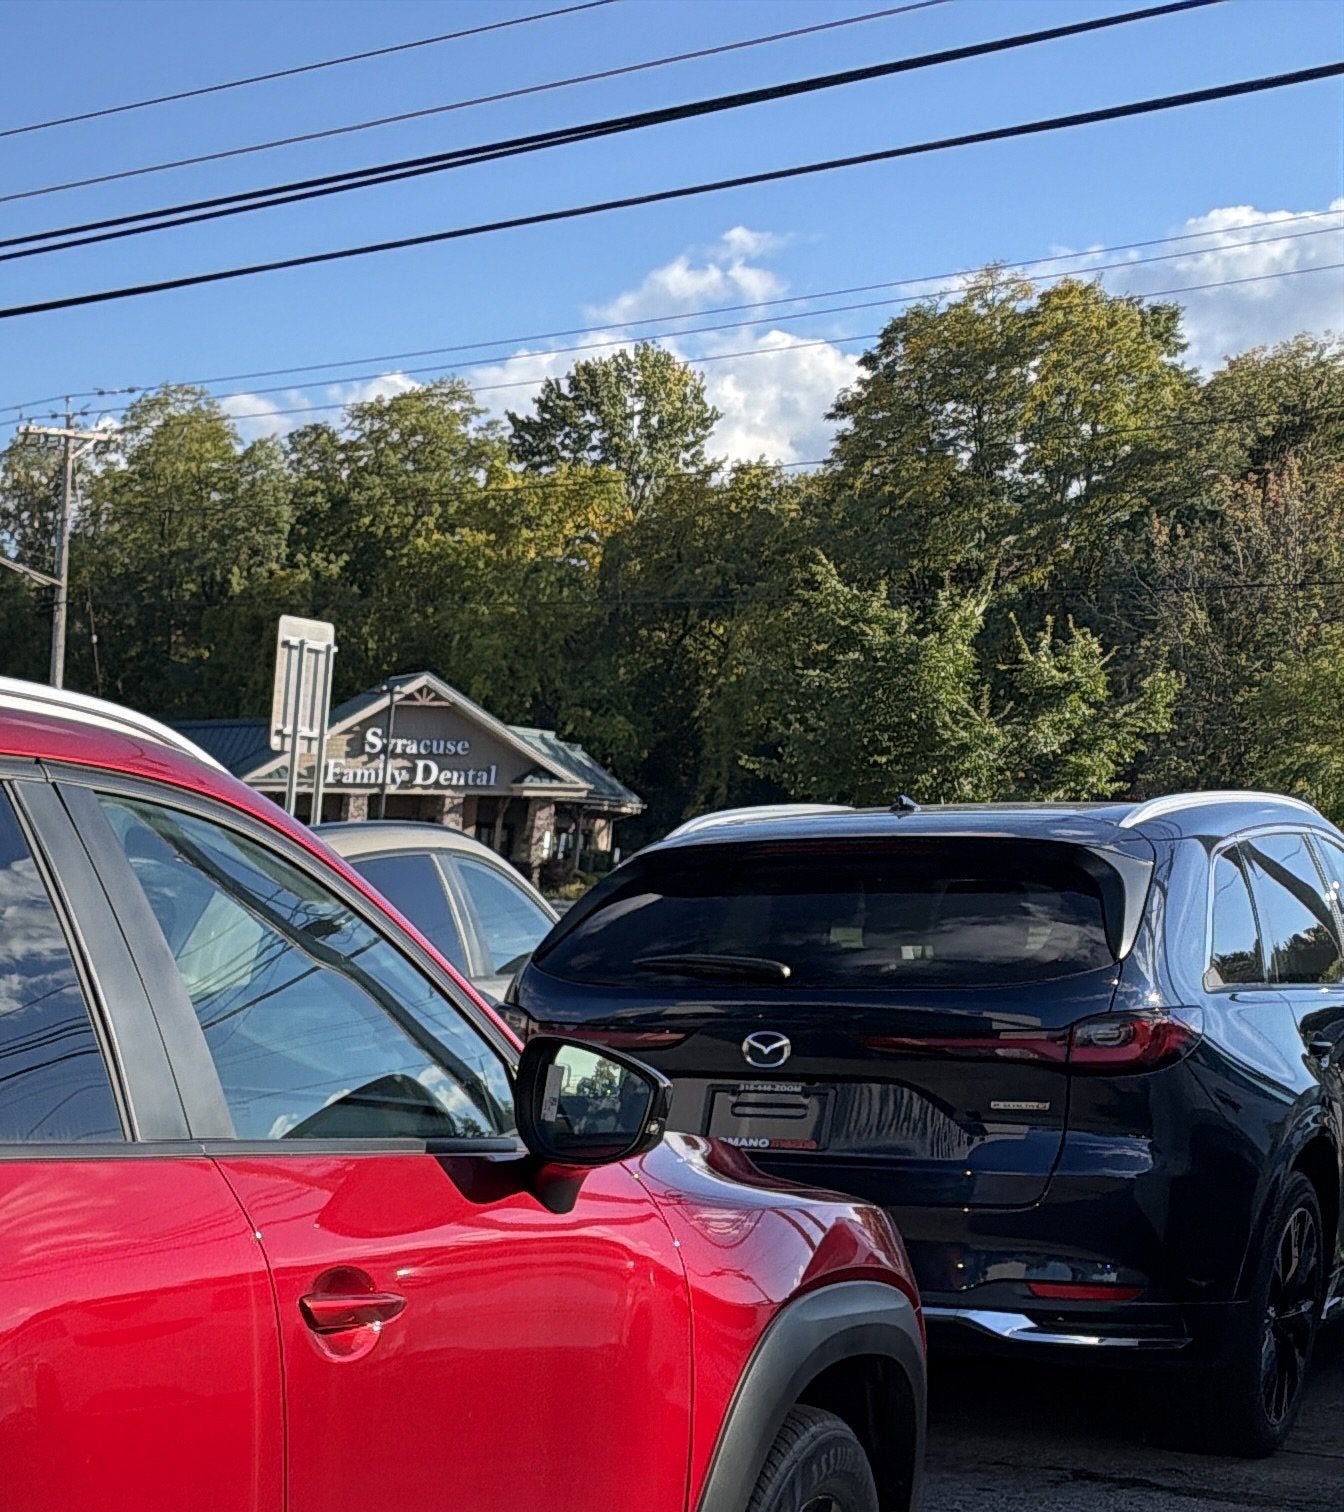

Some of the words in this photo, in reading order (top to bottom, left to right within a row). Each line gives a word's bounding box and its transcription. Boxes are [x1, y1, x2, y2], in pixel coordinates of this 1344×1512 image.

[364, 727, 470, 754] Syracuse
[324, 754, 410, 790] Family
[413, 759, 497, 786] Dental
[719, 1136, 769, 1148] MANO
